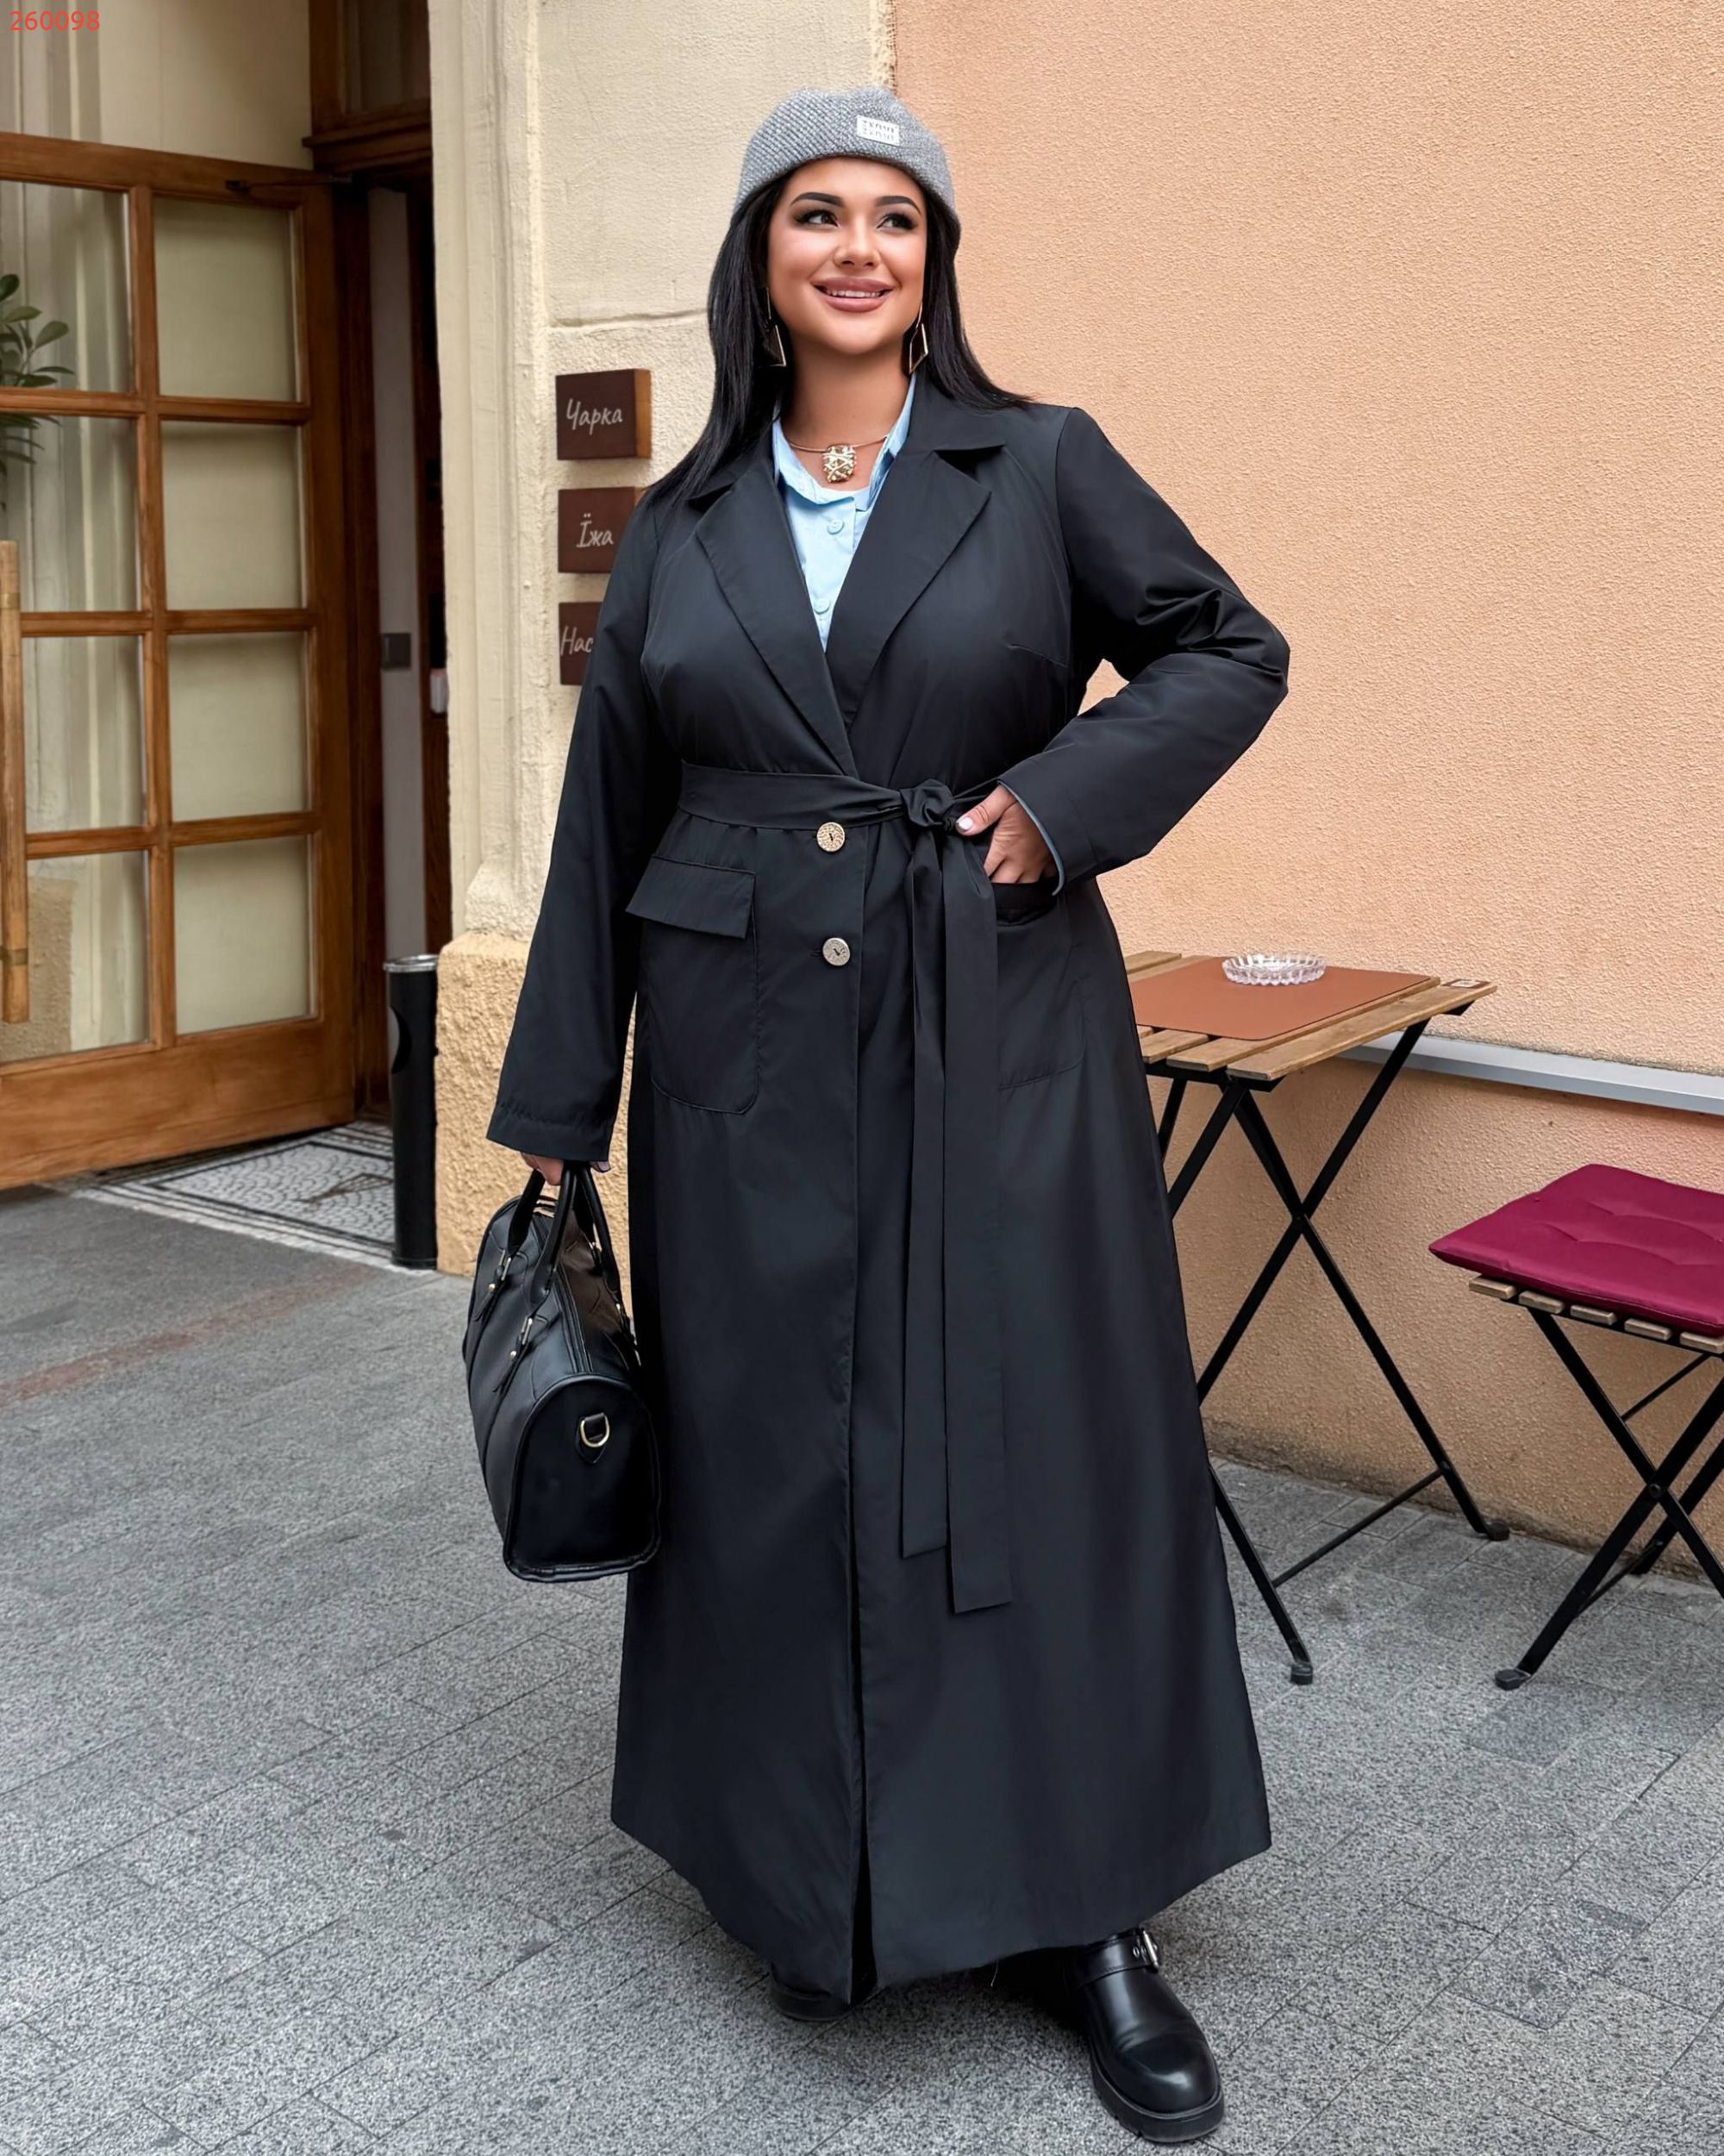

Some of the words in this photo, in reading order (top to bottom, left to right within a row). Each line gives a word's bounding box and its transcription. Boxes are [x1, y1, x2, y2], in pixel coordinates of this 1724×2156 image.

[565, 397, 624, 436] Чарка
[576, 513, 614, 548] Їжа
[560, 625, 594, 656] Нас
